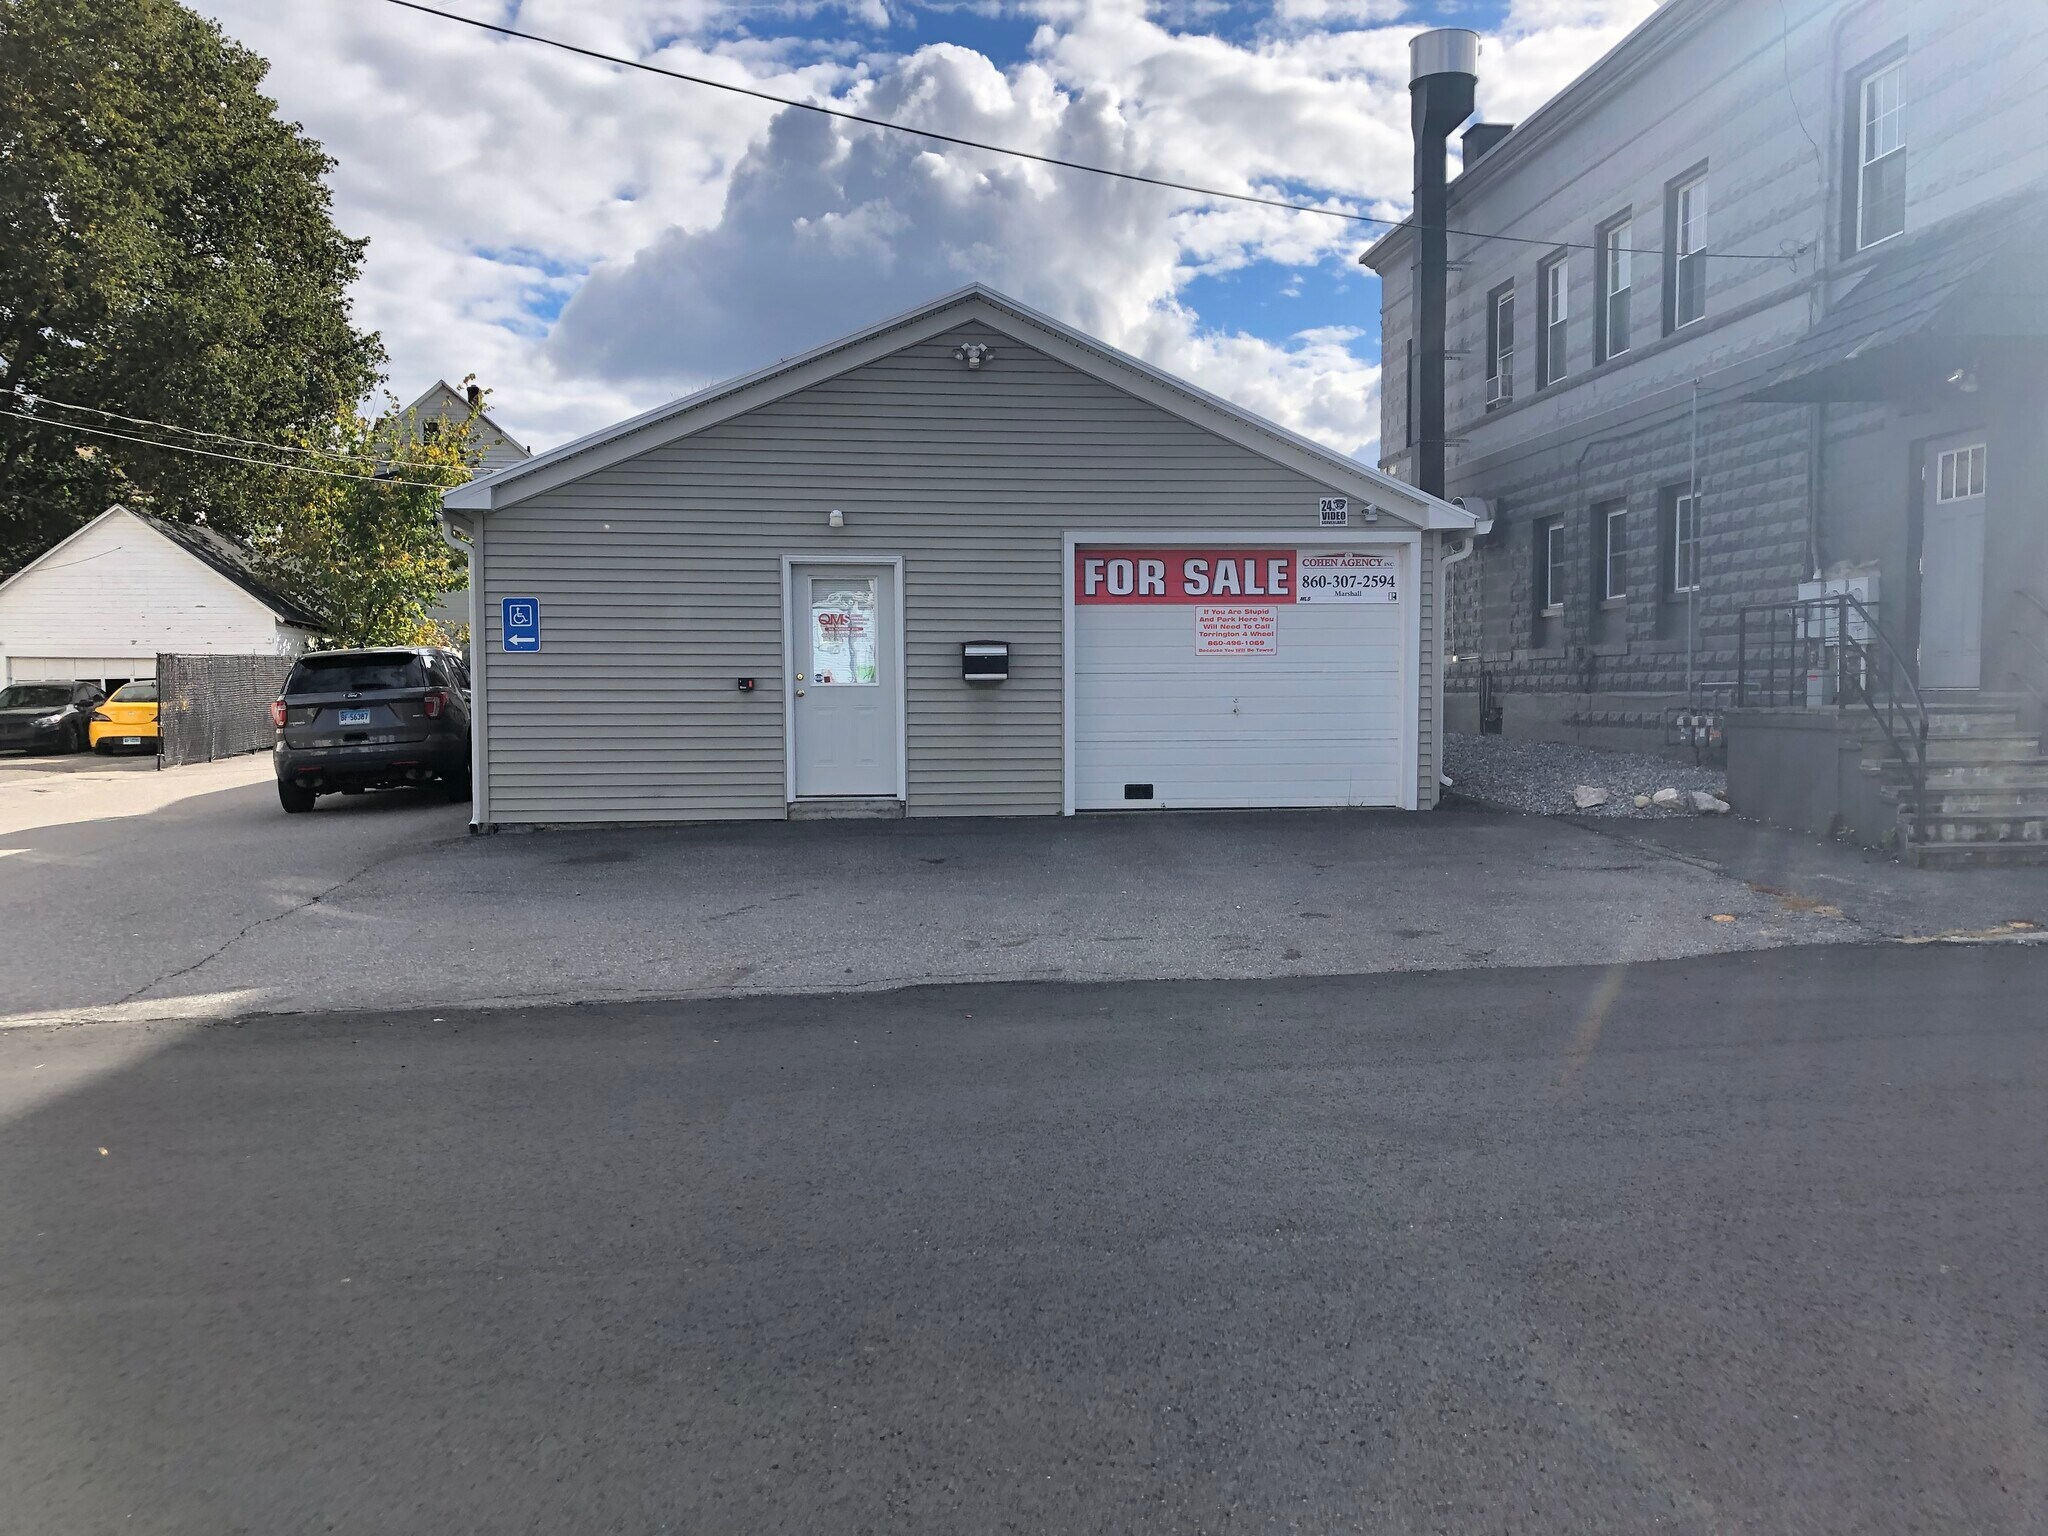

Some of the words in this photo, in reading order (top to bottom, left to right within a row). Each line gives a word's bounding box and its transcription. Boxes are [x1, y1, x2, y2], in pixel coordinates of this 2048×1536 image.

[1321, 500, 1332, 511] 24
[1321, 512, 1346, 520] VIDEO
[1302, 558, 1338, 567] COHEN
[1340, 558, 1384, 567] AGENCY
[1084, 558, 1166, 596] FOR
[1183, 558, 1290, 596] SALE
[1302, 575, 1396, 588] 860-307-2594
[818, 613, 850, 625] QMS
